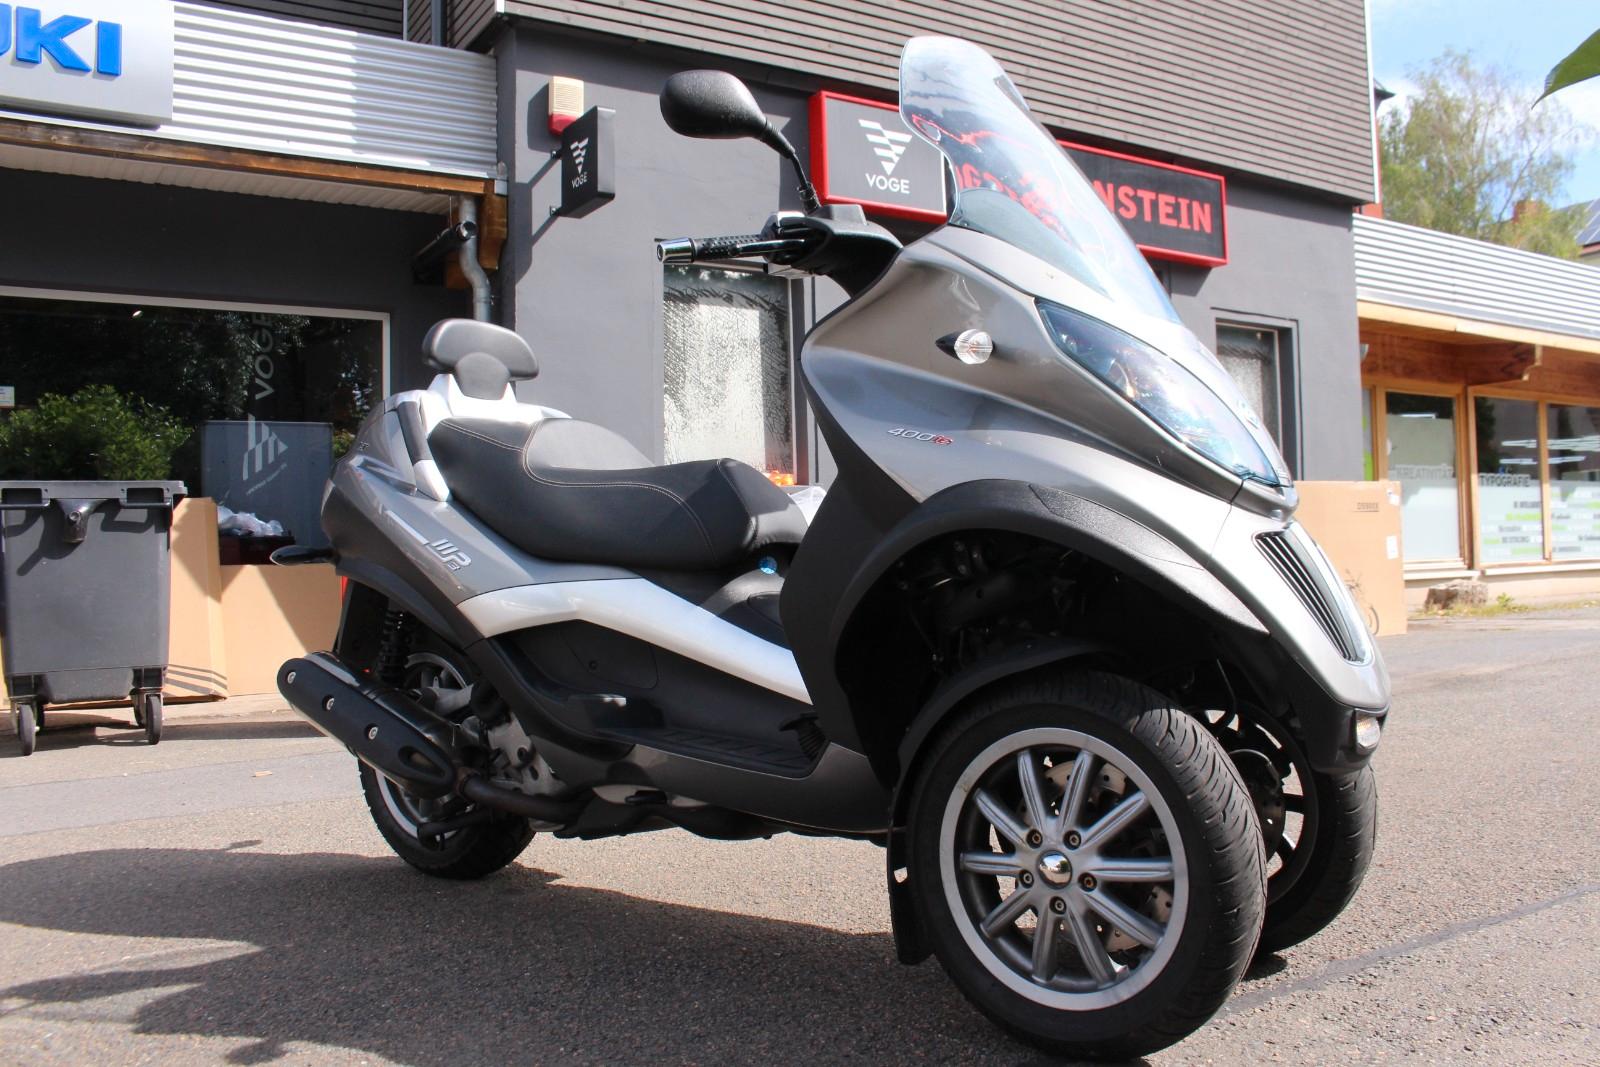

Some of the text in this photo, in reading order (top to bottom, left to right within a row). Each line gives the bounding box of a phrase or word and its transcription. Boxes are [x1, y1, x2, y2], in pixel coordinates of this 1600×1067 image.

[571, 172, 588, 189] VOGE
[865, 173, 910, 194] VOGE
[252, 311, 275, 399] VOGE
[1479, 474, 1530, 488] TYPOGRAFIE
